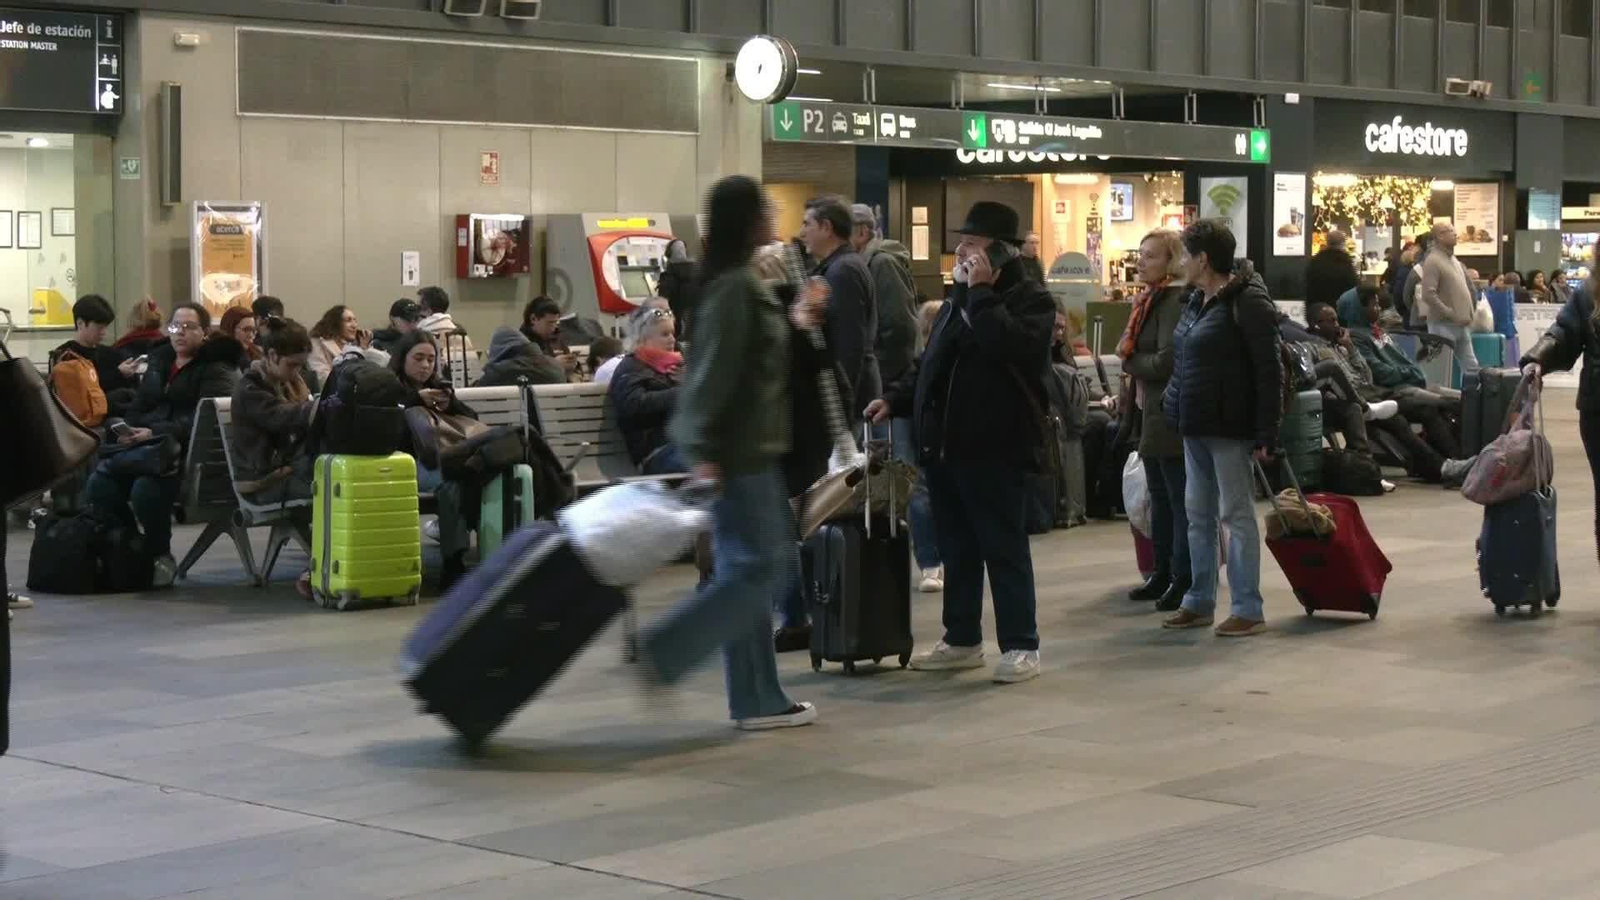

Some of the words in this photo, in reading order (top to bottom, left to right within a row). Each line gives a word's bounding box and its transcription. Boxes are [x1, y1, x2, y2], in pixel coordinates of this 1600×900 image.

[0, 20, 24, 34] Jefe
[27, 22, 42, 35] de
[45, 25, 92, 38] estación
[1, 40, 29, 50] STATION
[30, 42, 58, 51] MASTER
[803, 109, 824, 133] P2
[1365, 115, 1468, 157] cafestore
